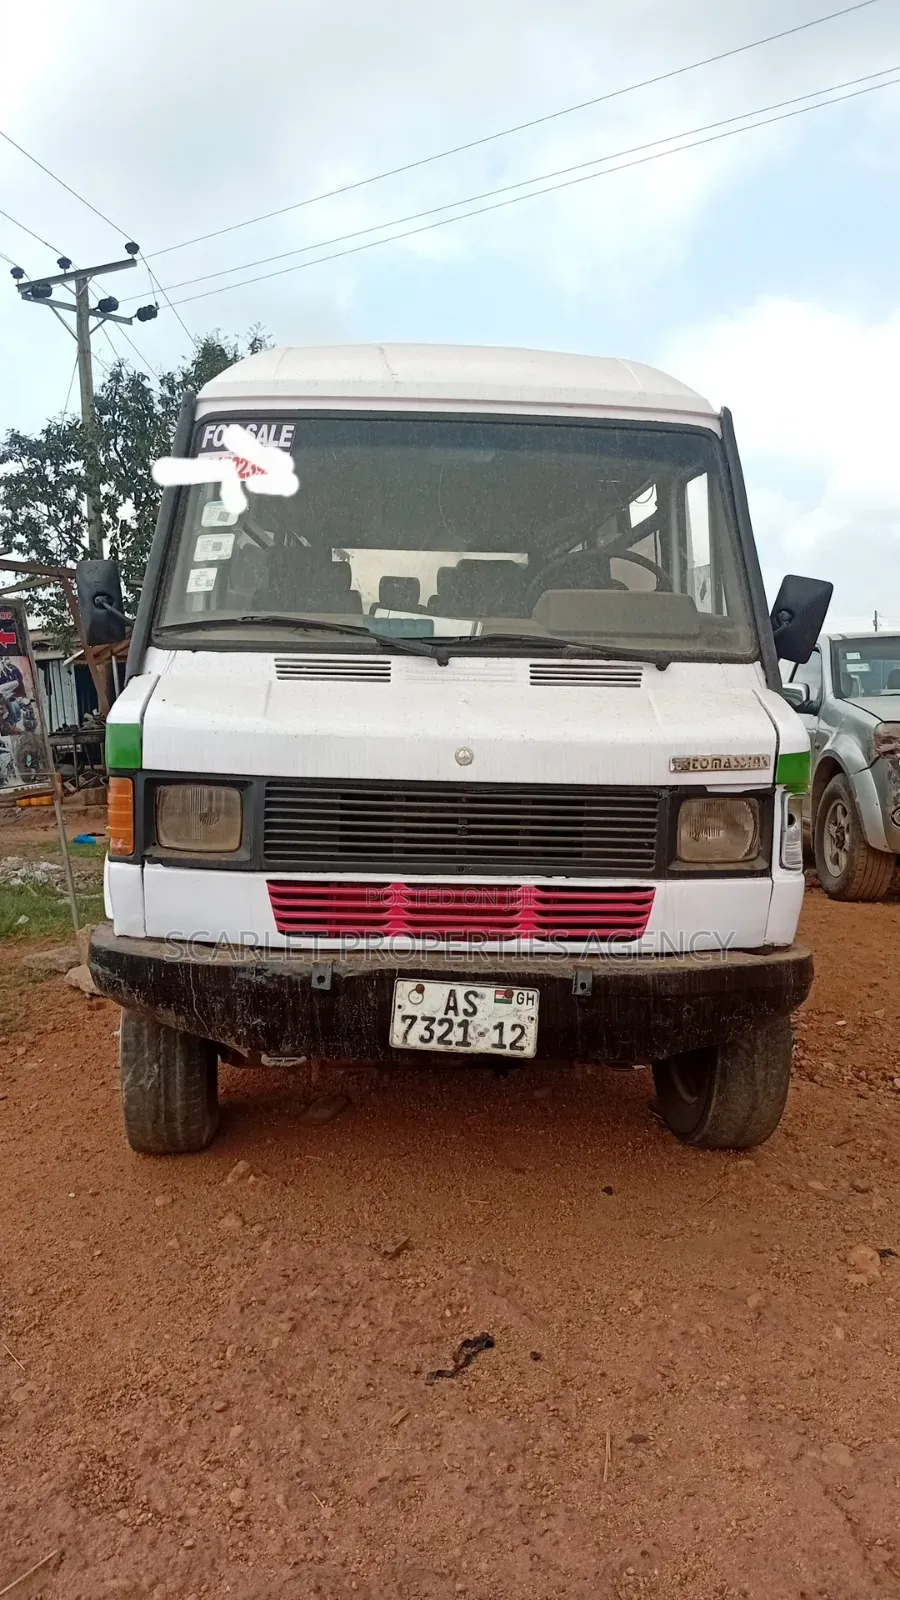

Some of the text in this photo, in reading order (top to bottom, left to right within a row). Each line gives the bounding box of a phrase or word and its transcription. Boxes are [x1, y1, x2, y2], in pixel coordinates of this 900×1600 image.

[201, 424, 230, 448] FO
[443, 989, 535, 1018] AS GH
[491, 1021, 526, 1051] 12
